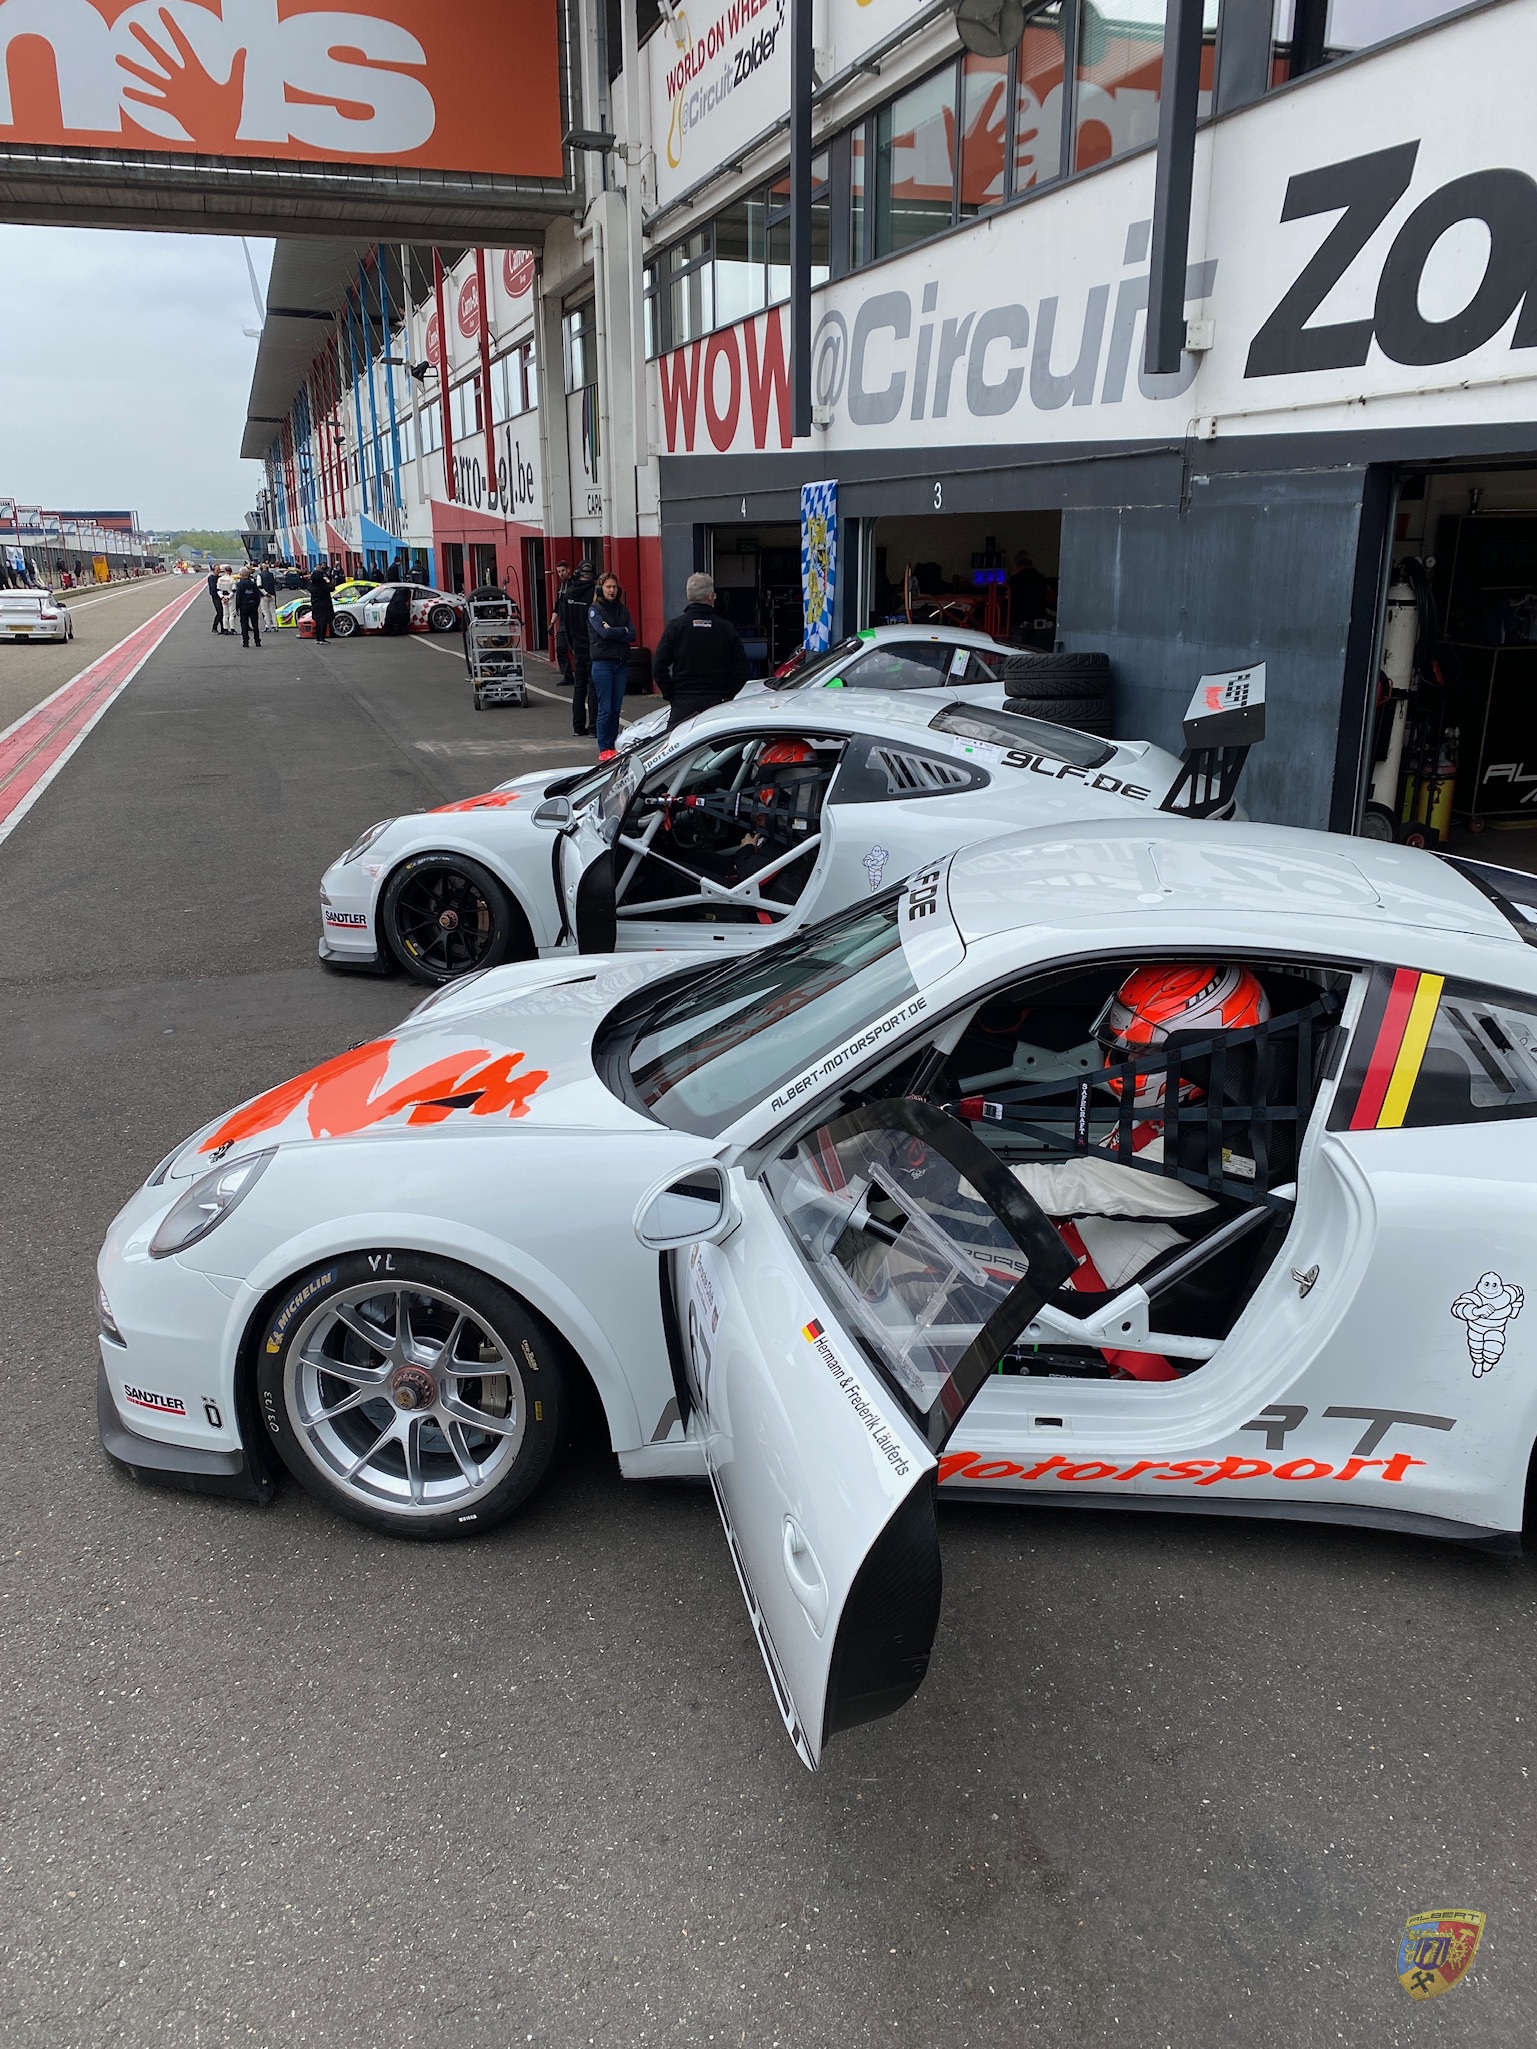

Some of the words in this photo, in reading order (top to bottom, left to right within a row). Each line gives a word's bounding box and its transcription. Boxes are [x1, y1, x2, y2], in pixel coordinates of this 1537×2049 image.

[666, 40, 705, 102] WORLD
[707, 15, 725, 60] ON
[727, 0, 769, 39] WHE
[659, 305, 793, 453] WOW
[1243, 138, 1537, 379] Zo
[442, 425, 534, 515] arro-el.be
[741, 498, 747, 517] 4
[934, 482, 942, 509] 3
[1001, 750, 1151, 801] 9LF.DE
[325, 910, 367, 925] SANDTLER
[771, 997, 928, 1112] ALBERT-MOTORSPORT.DE
[1079, 1083, 1088, 1135] SAFECRAFT
[277, 1272, 332, 1331] MICHELIN
[813, 1336, 845, 1380] Hermann
[124, 1384, 185, 1410] SANDTLER
[839, 1376, 854, 1390] &
[844, 1384, 880, 1431] Frederik
[263, 1391, 279, 1433] 03/23
[872, 1425, 909, 1476] Läuferts
